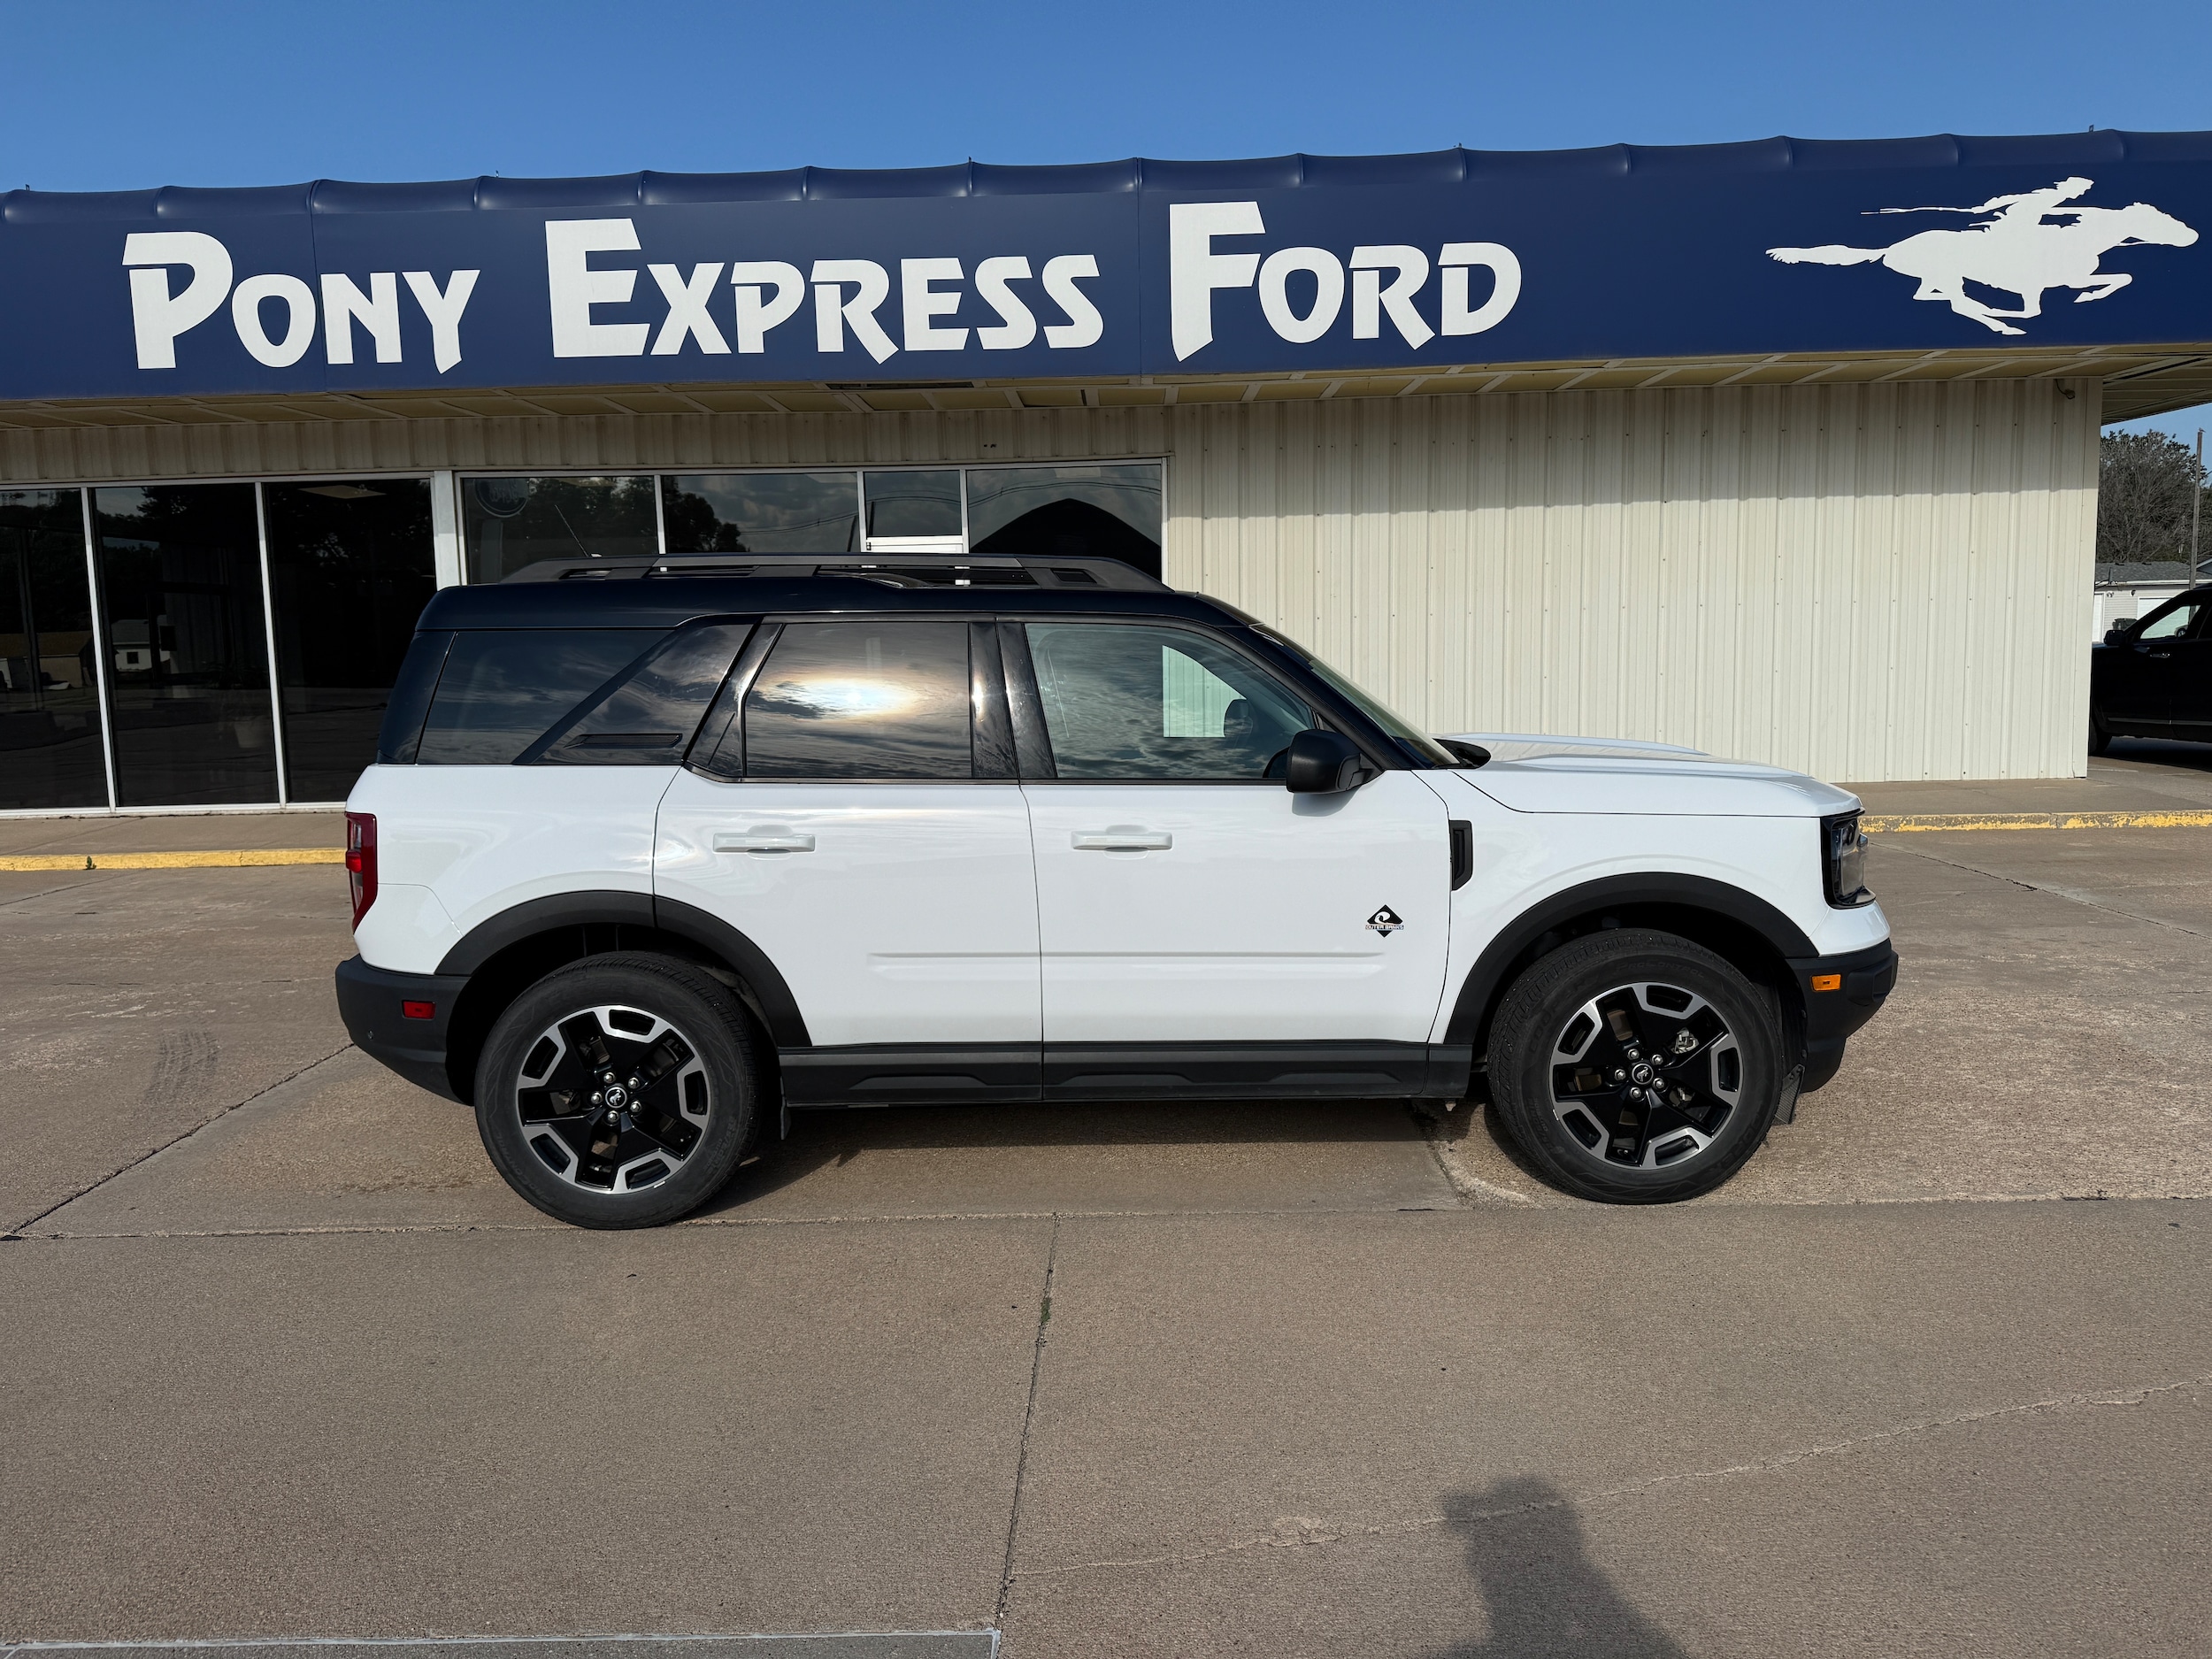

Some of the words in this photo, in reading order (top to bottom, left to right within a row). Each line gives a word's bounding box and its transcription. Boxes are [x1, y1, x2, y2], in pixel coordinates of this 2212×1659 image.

[123, 232, 480, 373] PONY
[546, 219, 1102, 364] EXPRESS
[1170, 202, 1521, 361] FORD
